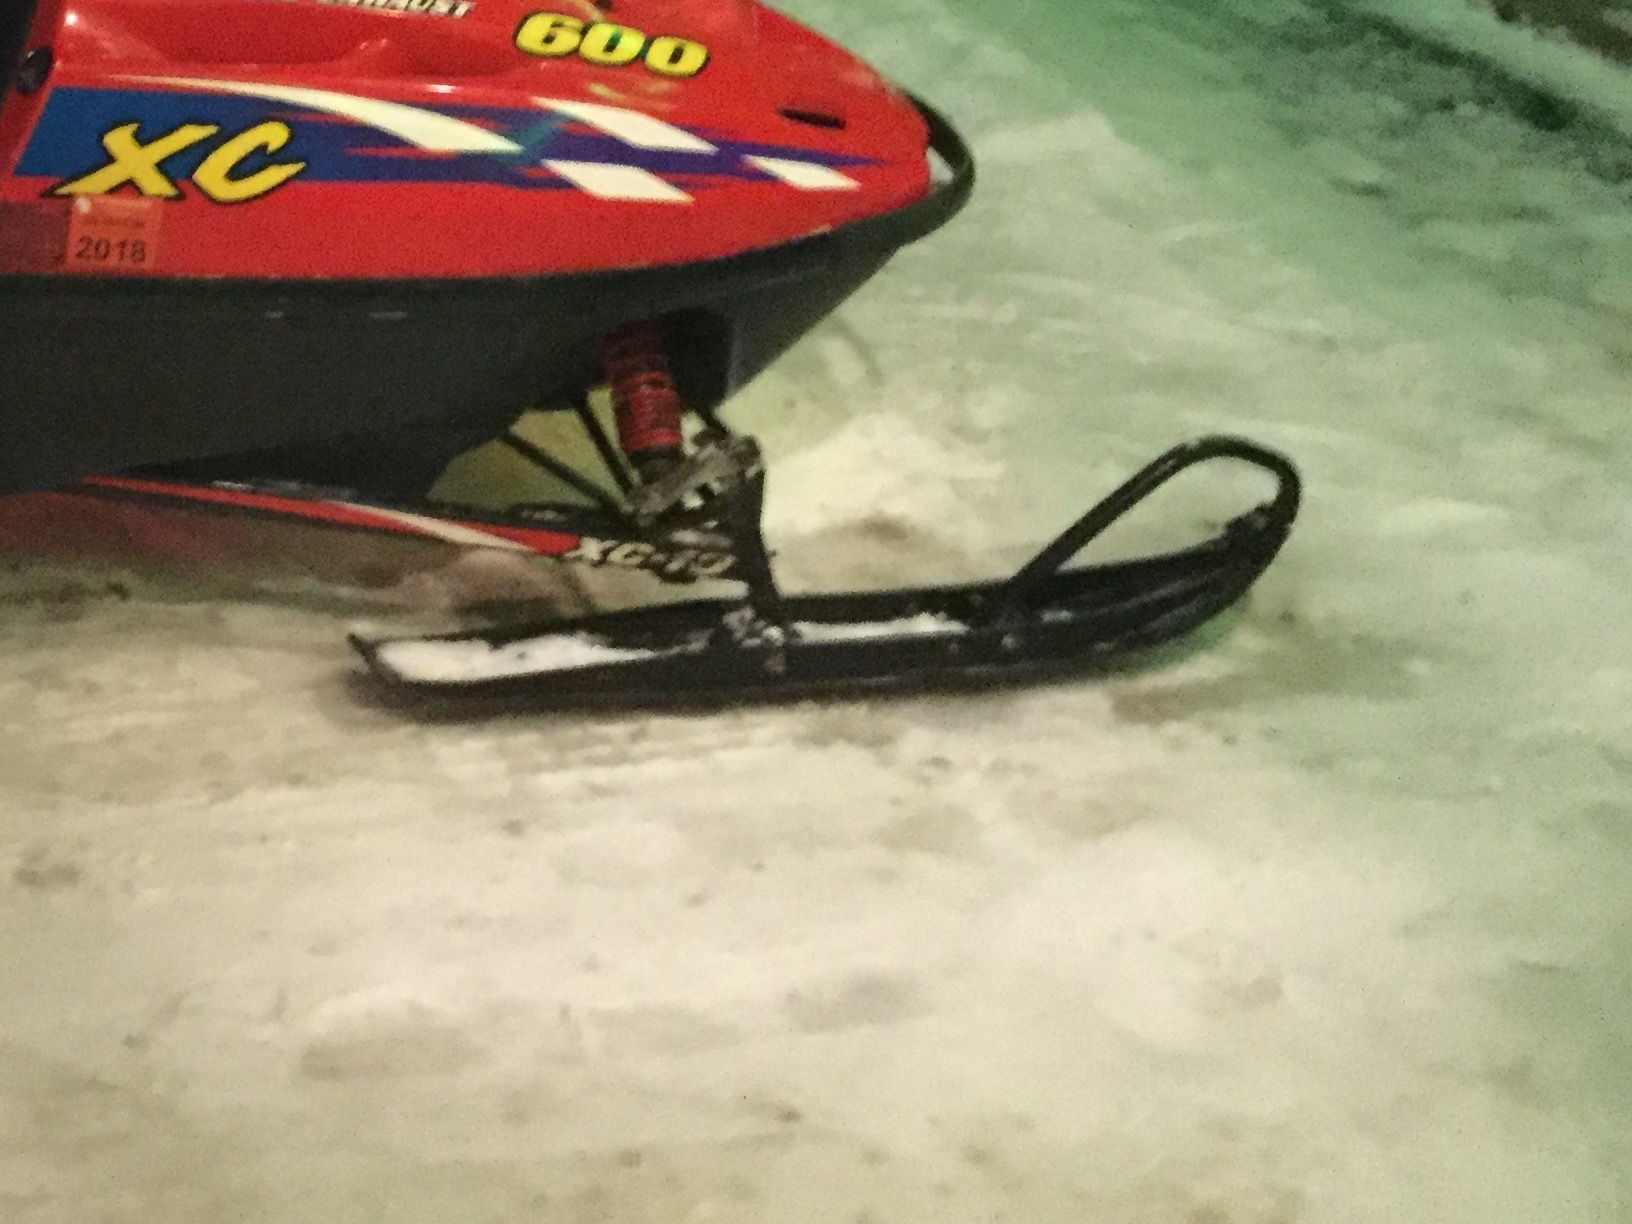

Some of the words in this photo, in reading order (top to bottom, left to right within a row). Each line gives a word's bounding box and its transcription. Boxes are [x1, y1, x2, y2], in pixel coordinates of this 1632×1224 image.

[513, 11, 711, 78] 600
[43, 119, 307, 204] XC
[75, 235, 147, 263] 2018
